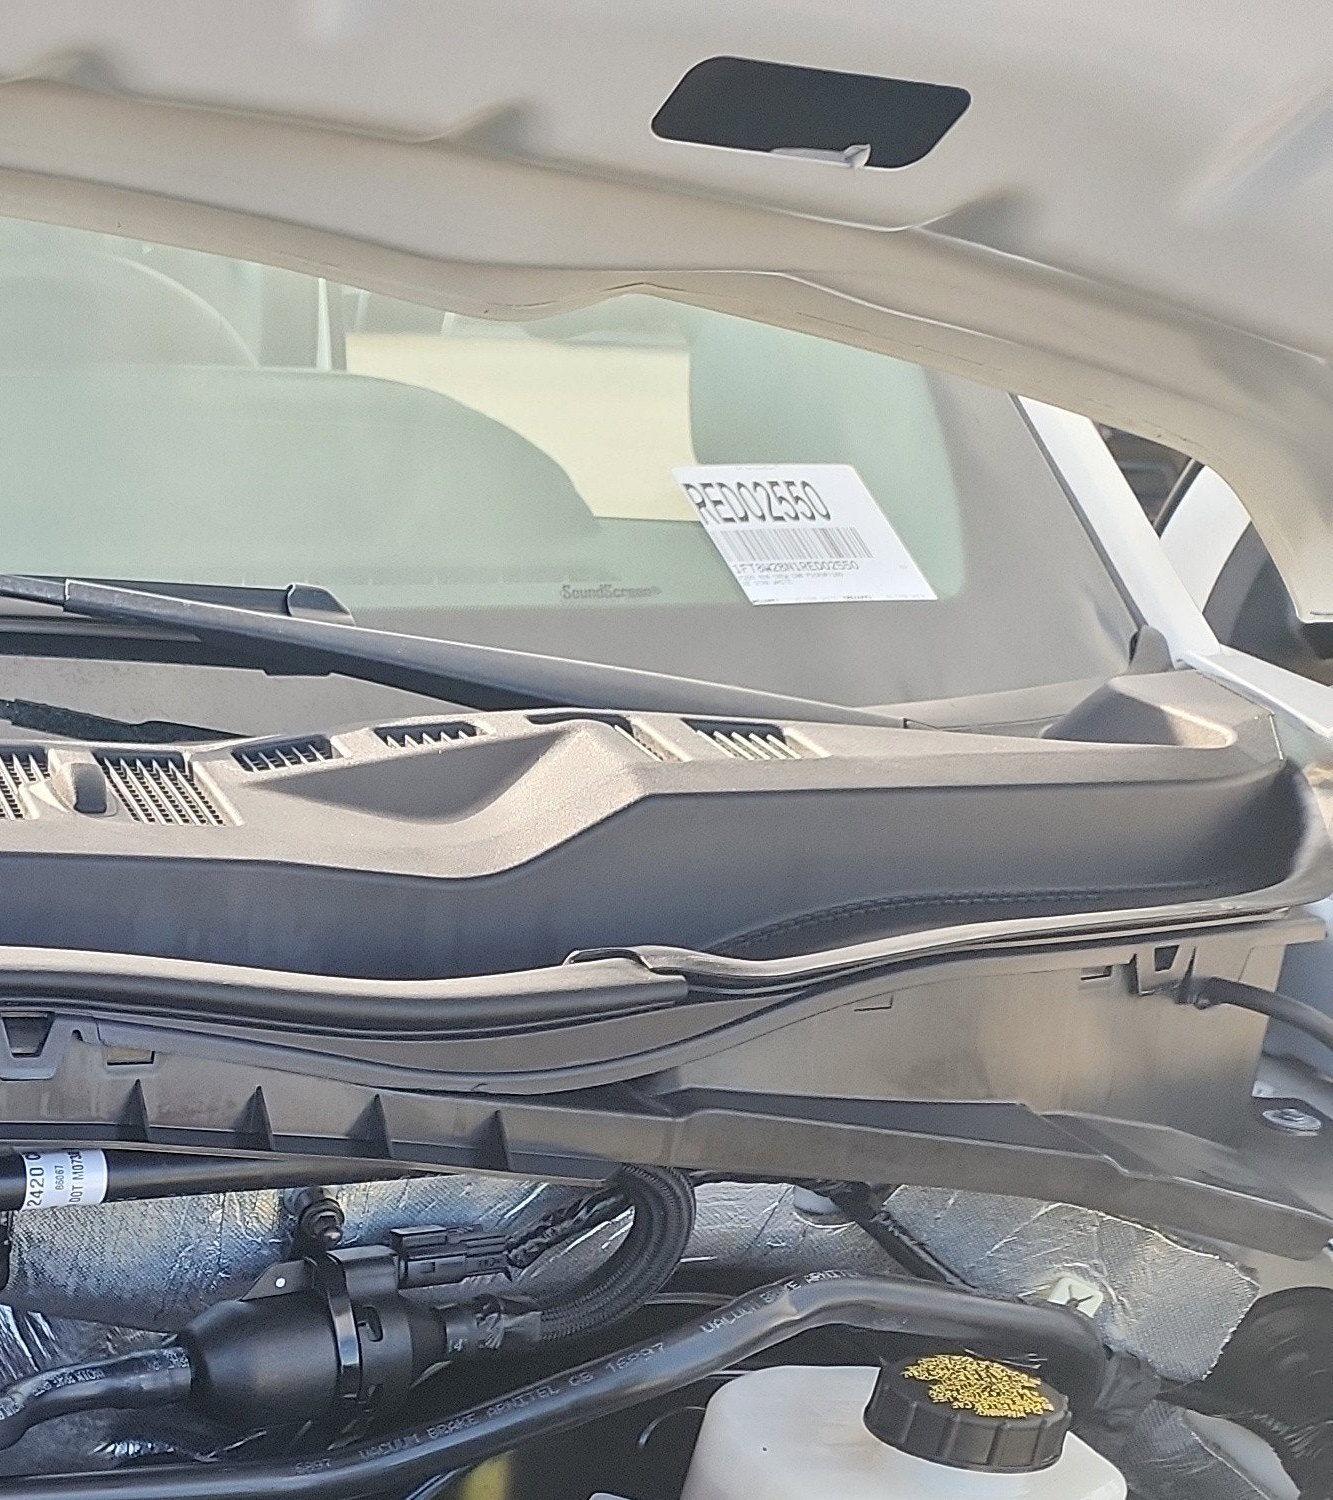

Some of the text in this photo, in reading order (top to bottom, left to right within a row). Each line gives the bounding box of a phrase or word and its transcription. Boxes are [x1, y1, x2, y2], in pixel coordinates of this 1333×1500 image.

[683, 480, 831, 524] RED02550
[26, 1167, 46, 1206] 2420
[69, 1185, 84, 1203] DOT
